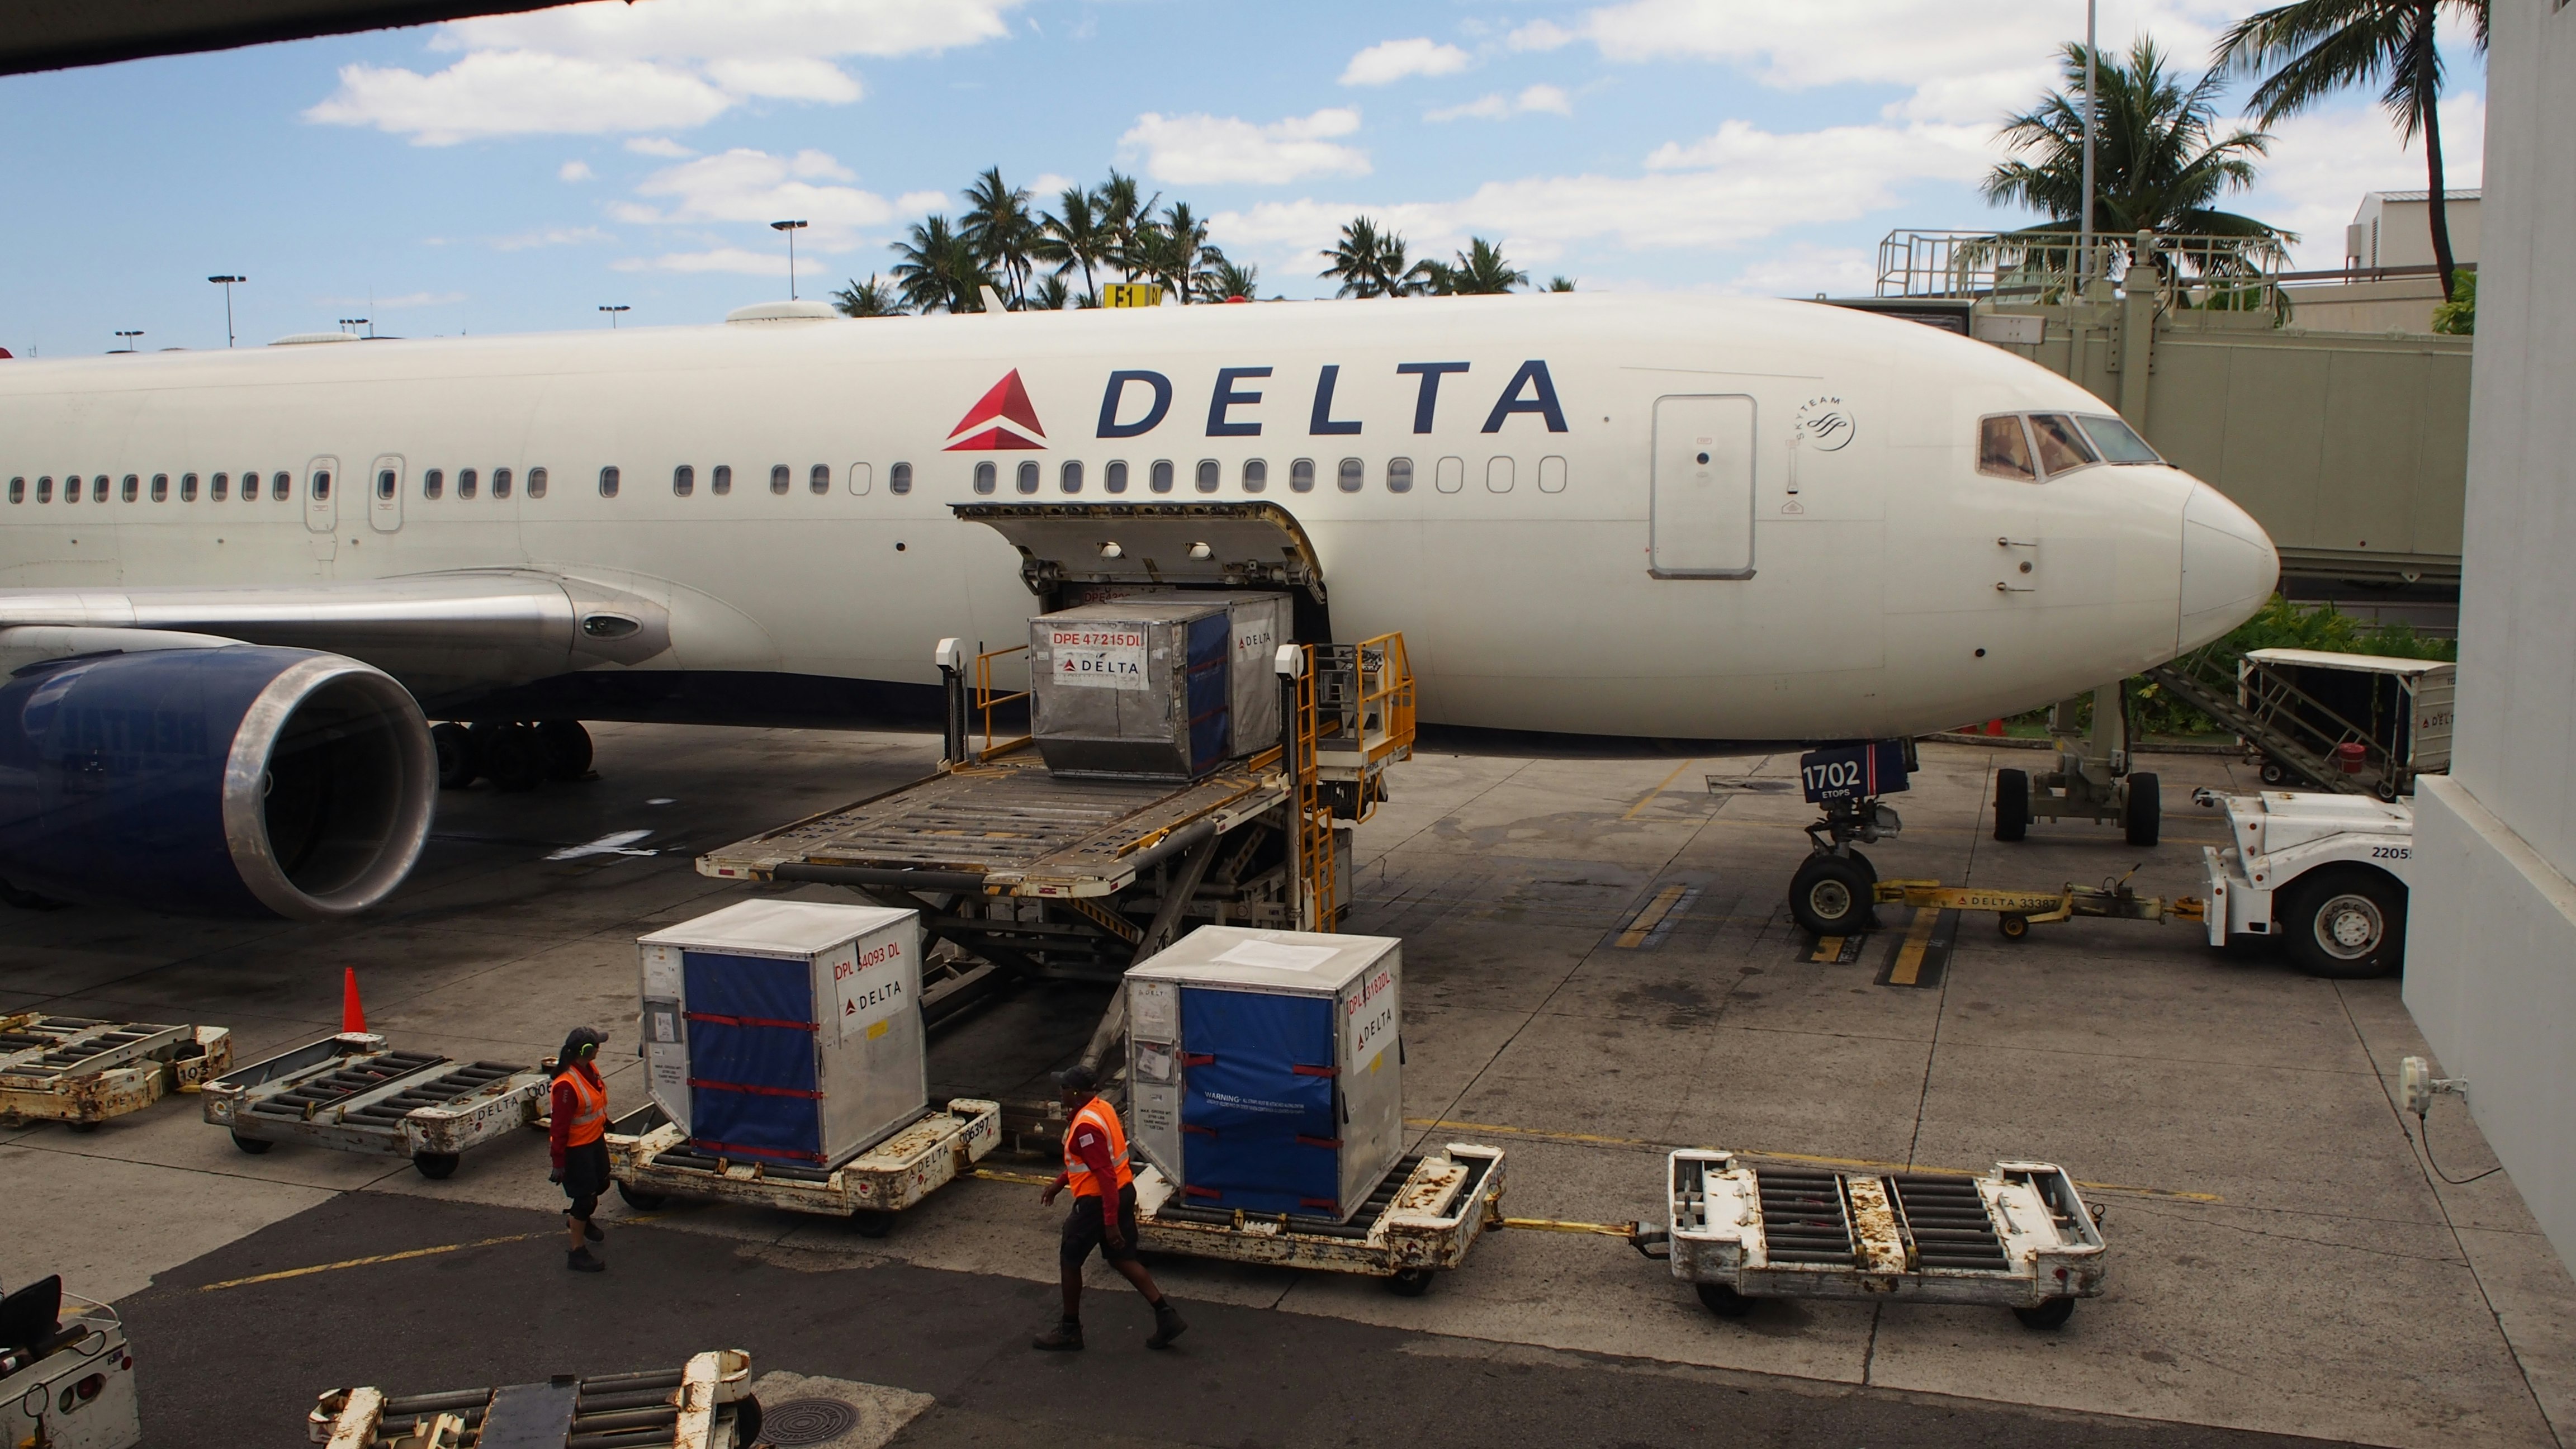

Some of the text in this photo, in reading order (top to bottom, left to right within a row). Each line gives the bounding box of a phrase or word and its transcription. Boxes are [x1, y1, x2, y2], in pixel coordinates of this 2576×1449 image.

[1096, 359, 1569, 439] DELTA
[1794, 396, 1841, 441] SKYTEAM
[1054, 633, 1079, 645] DPE
[1083, 634, 1124, 646] 47215
[1246, 632, 1271, 646] DELTA
[1082, 660, 1138, 674] DELTA
[2432, 714, 2454, 726] DELT
[1803, 761, 1860, 790] 1702
[1822, 789, 1850, 799] ETOPS
[1972, 897, 2057, 909] DELTA 33387
[835, 960, 854, 981] DPL
[888, 941, 901, 958] DL
[859, 981, 902, 1010] DELTA
[1364, 1008, 1392, 1042] DELTA
[478, 1096, 519, 1120] DELTA
[918, 1144, 949, 1173] DELTA
